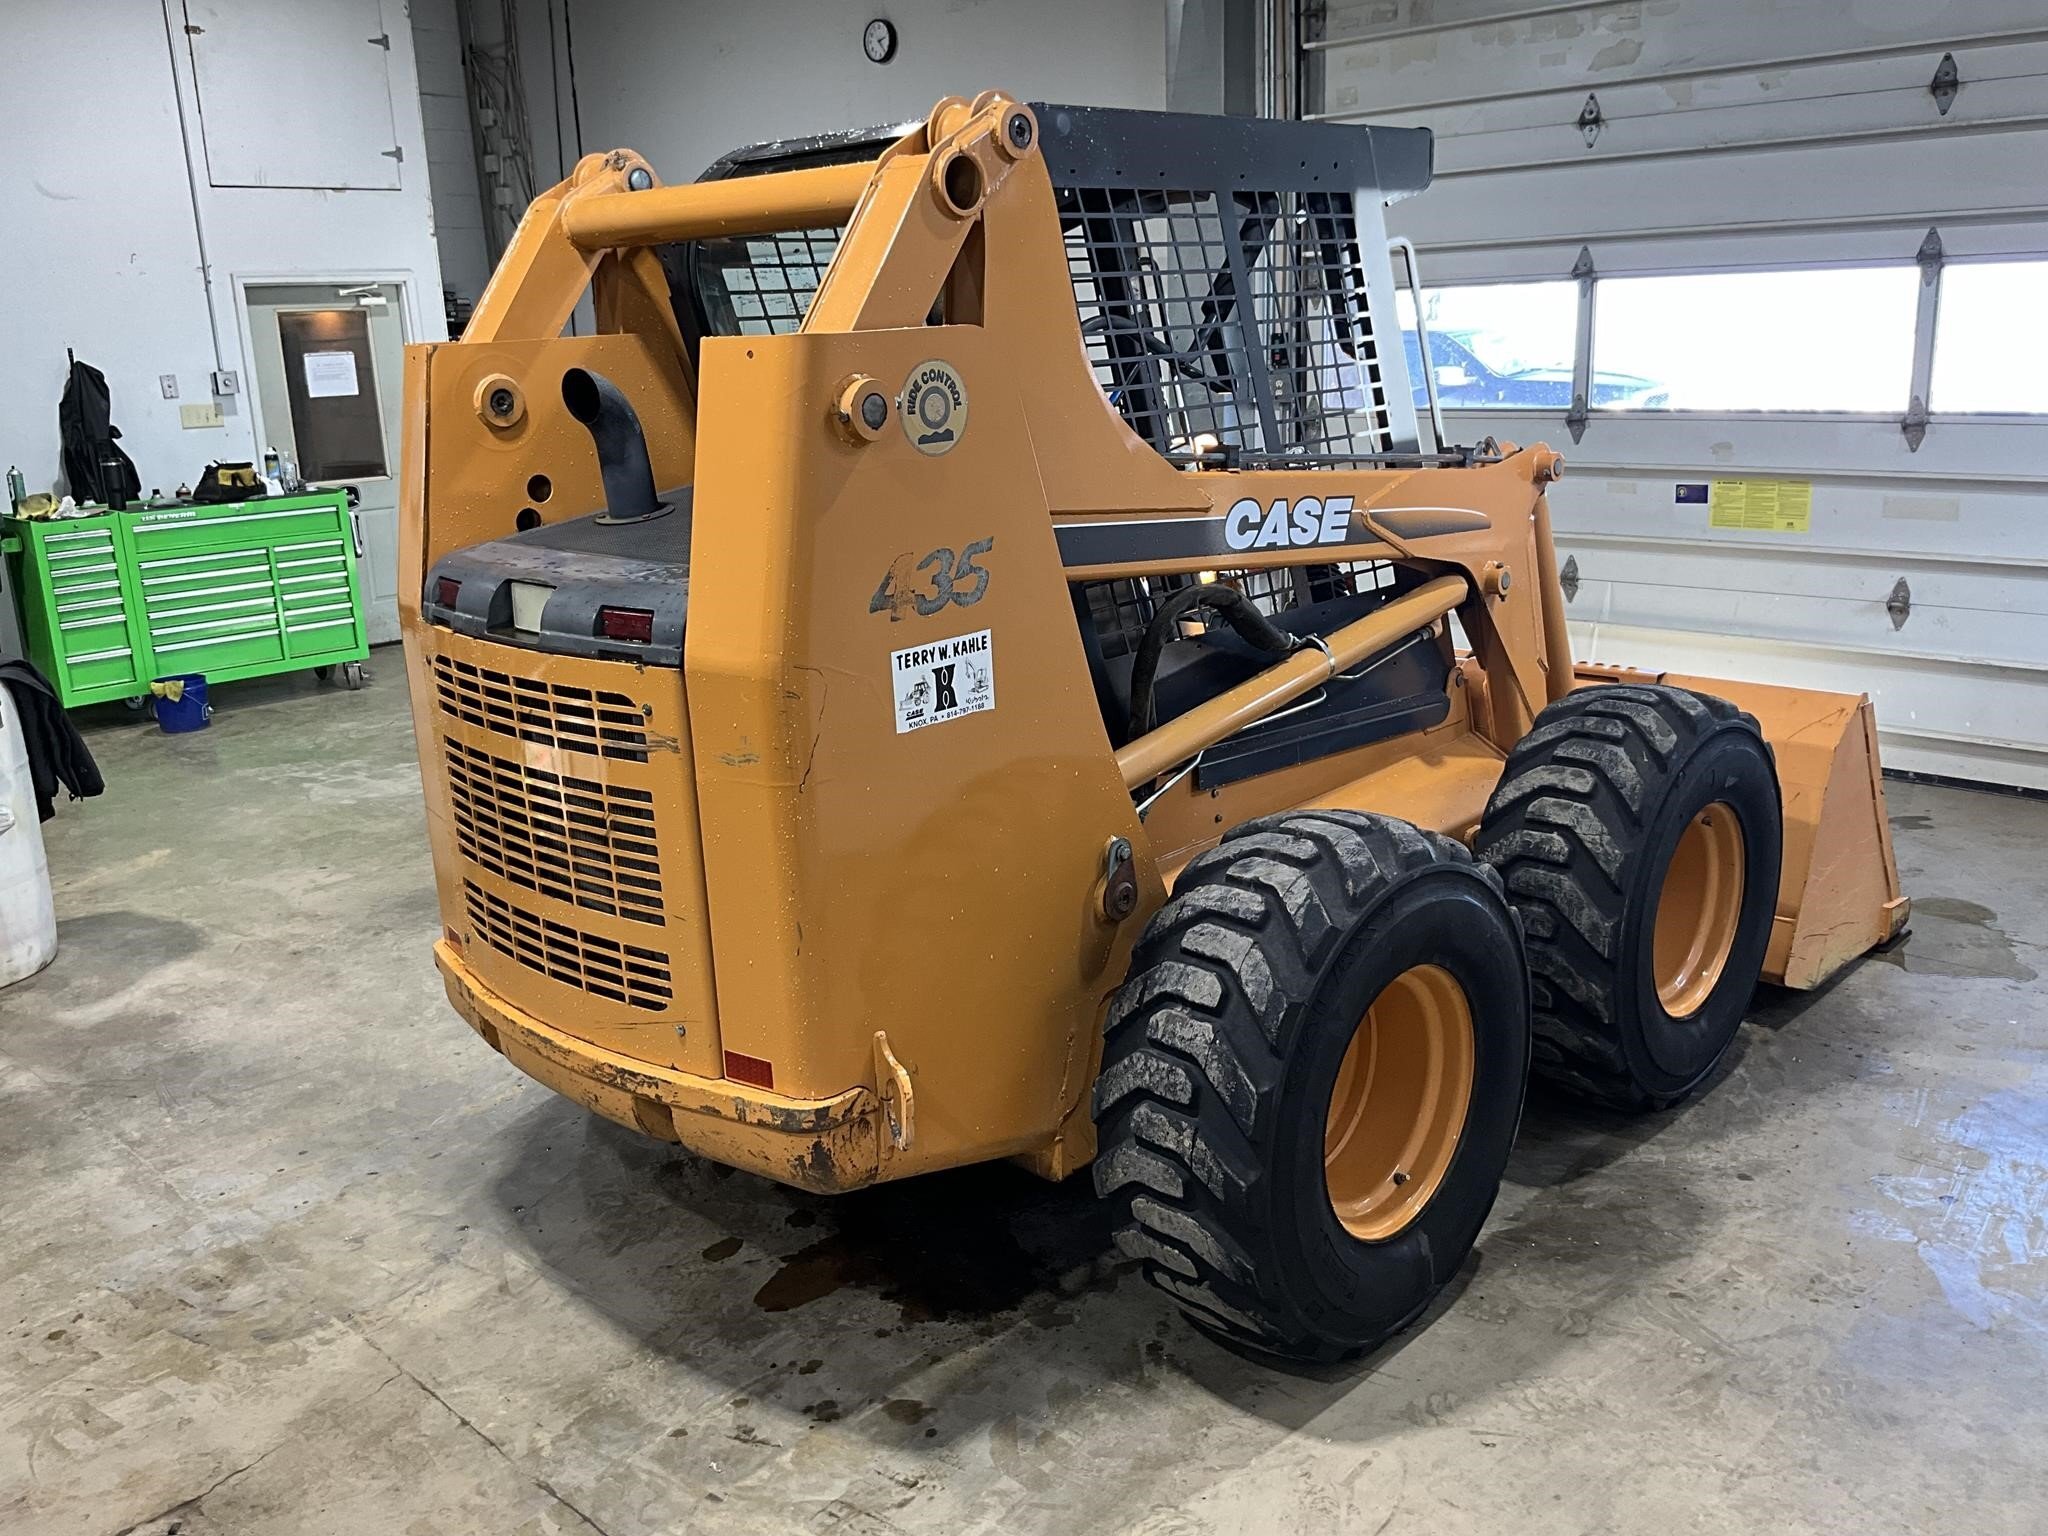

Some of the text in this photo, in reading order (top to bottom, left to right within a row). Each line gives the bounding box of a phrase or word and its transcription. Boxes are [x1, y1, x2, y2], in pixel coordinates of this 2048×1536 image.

[907, 369, 962, 415] RIDE CONTROL
[1225, 496, 1355, 550] CASE
[869, 536, 994, 622] 435
[896, 635, 988, 671] TERRY W. KAHLE
[906, 708, 924, 717] CASE
[930, 714, 939, 723] PA
